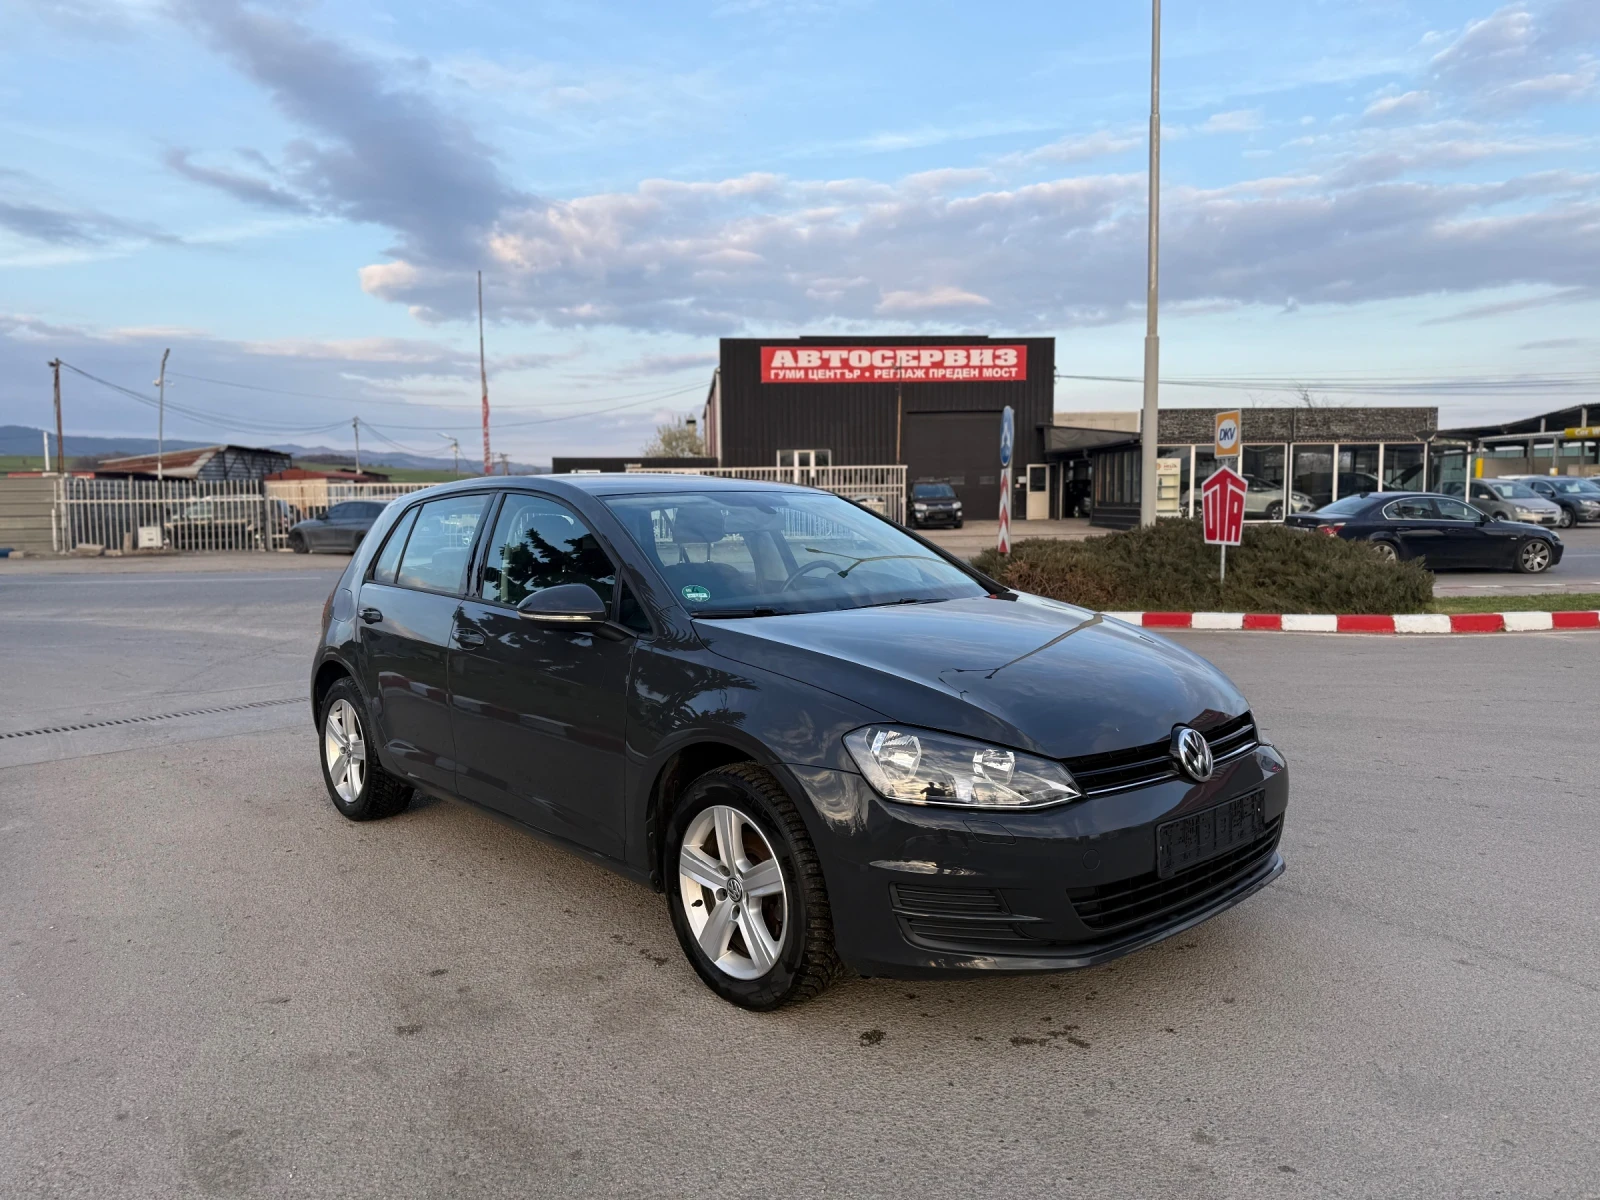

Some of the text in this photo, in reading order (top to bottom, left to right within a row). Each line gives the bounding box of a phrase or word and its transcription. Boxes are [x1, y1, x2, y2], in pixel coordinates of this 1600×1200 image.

[771, 349, 1018, 368] АВТОСЕРВИЗ
[770, 367, 1018, 381] ГУМИ ЦЕНТЪР РЕГЛАЖ ПРЕДЕН МОСТ
[1219, 427, 1236, 441] DKV
